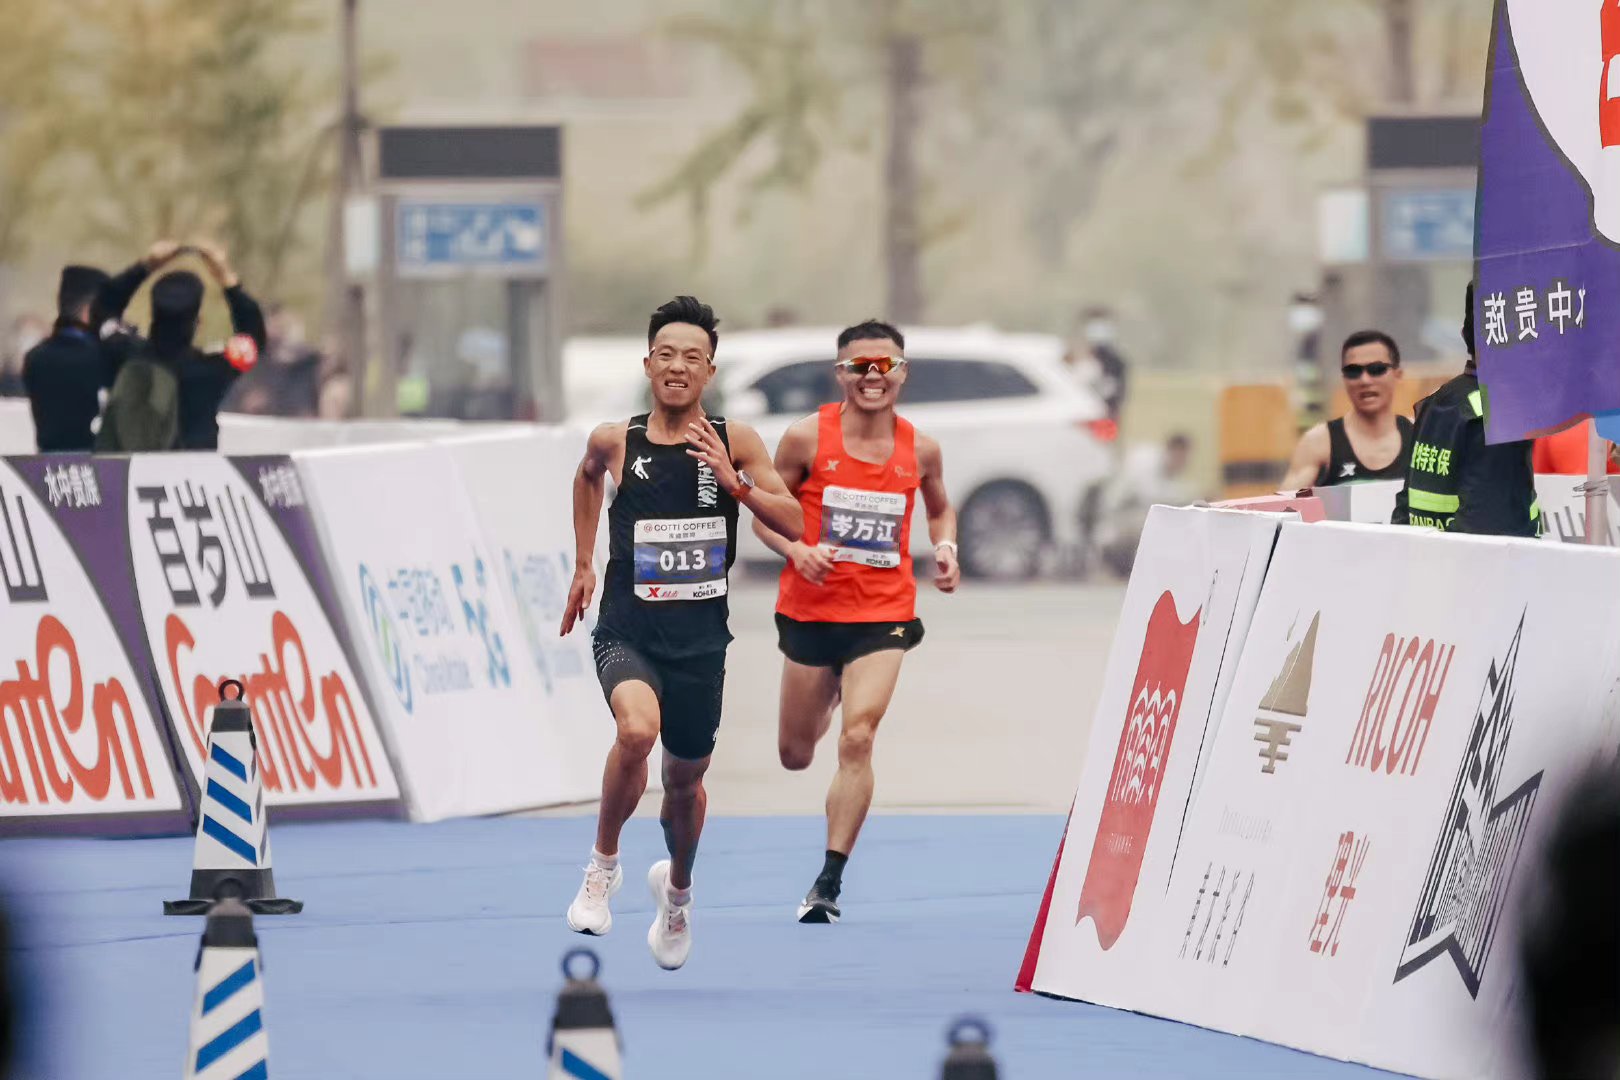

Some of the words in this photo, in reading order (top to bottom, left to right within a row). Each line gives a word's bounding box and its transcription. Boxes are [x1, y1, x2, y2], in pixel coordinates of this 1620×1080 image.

[136, 480, 278, 610] 百岁山
[654, 523, 680, 532] COTTI
[682, 521, 717, 531] COFFEE
[660, 549, 706, 572] 013
[693, 588, 718, 598] KOHLER
[1346, 632, 1456, 776] RICOH
[1308, 831, 1371, 957] 理光
